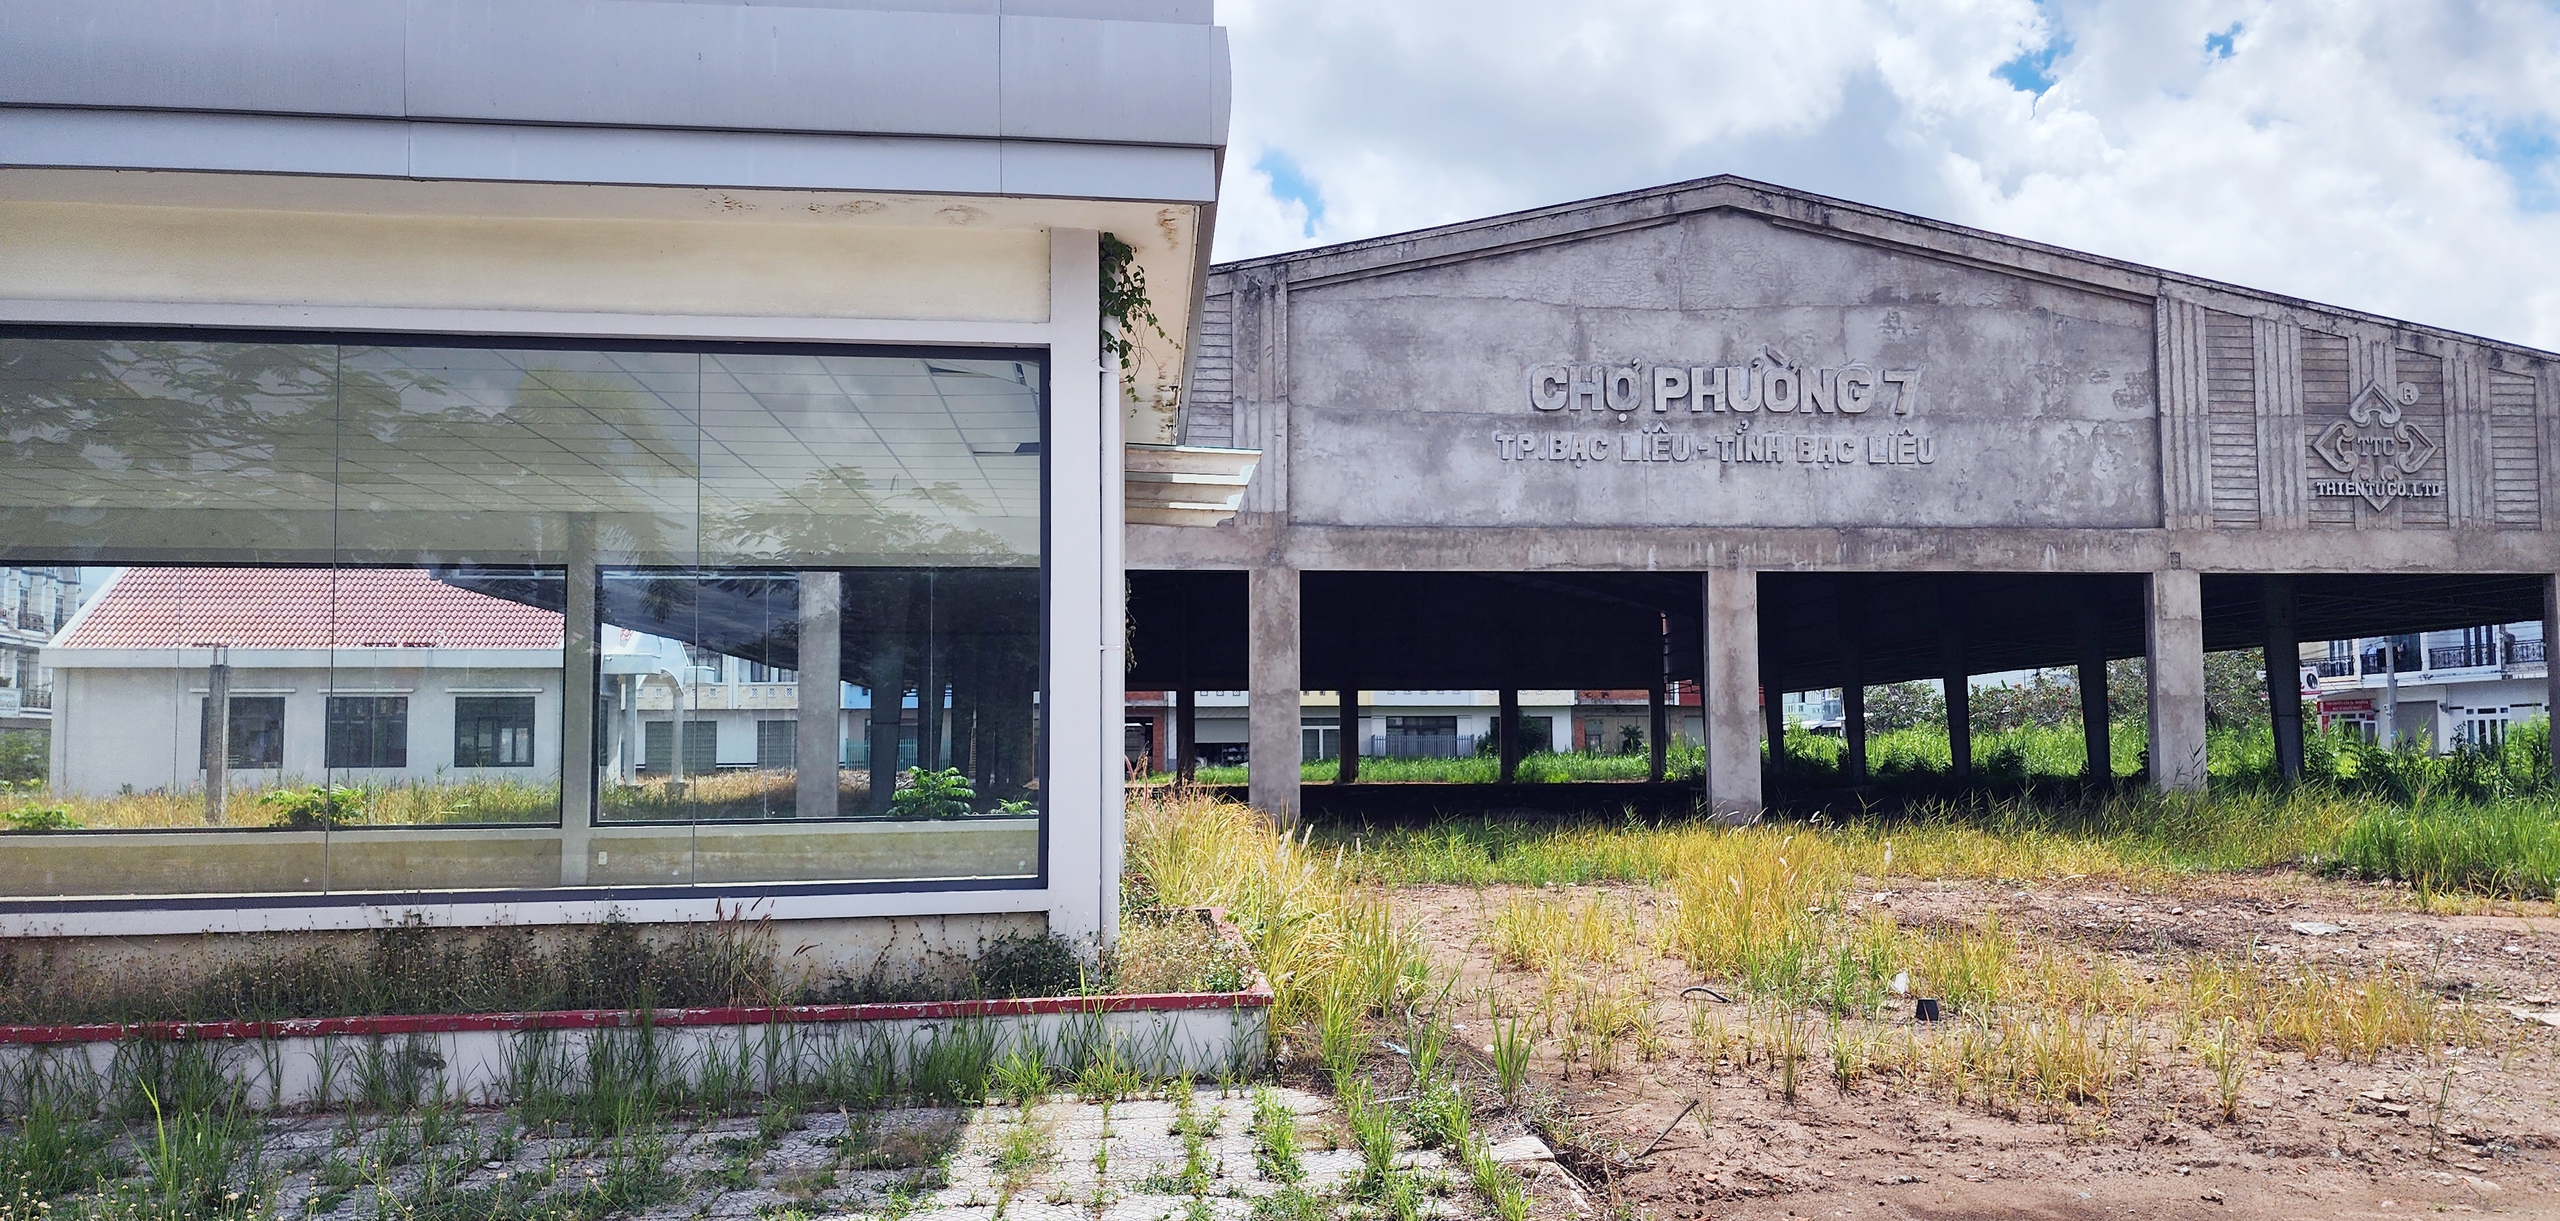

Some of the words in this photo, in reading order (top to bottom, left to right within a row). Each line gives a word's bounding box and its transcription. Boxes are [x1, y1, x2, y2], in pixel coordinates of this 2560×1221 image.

[1531, 358, 1642, 422] CHỢ
[1653, 344, 1872, 414] PHƯỜNG
[1882, 369, 1921, 414] 7
[1796, 435, 1855, 470] BẠC
[2357, 437, 2395, 457] TTC
